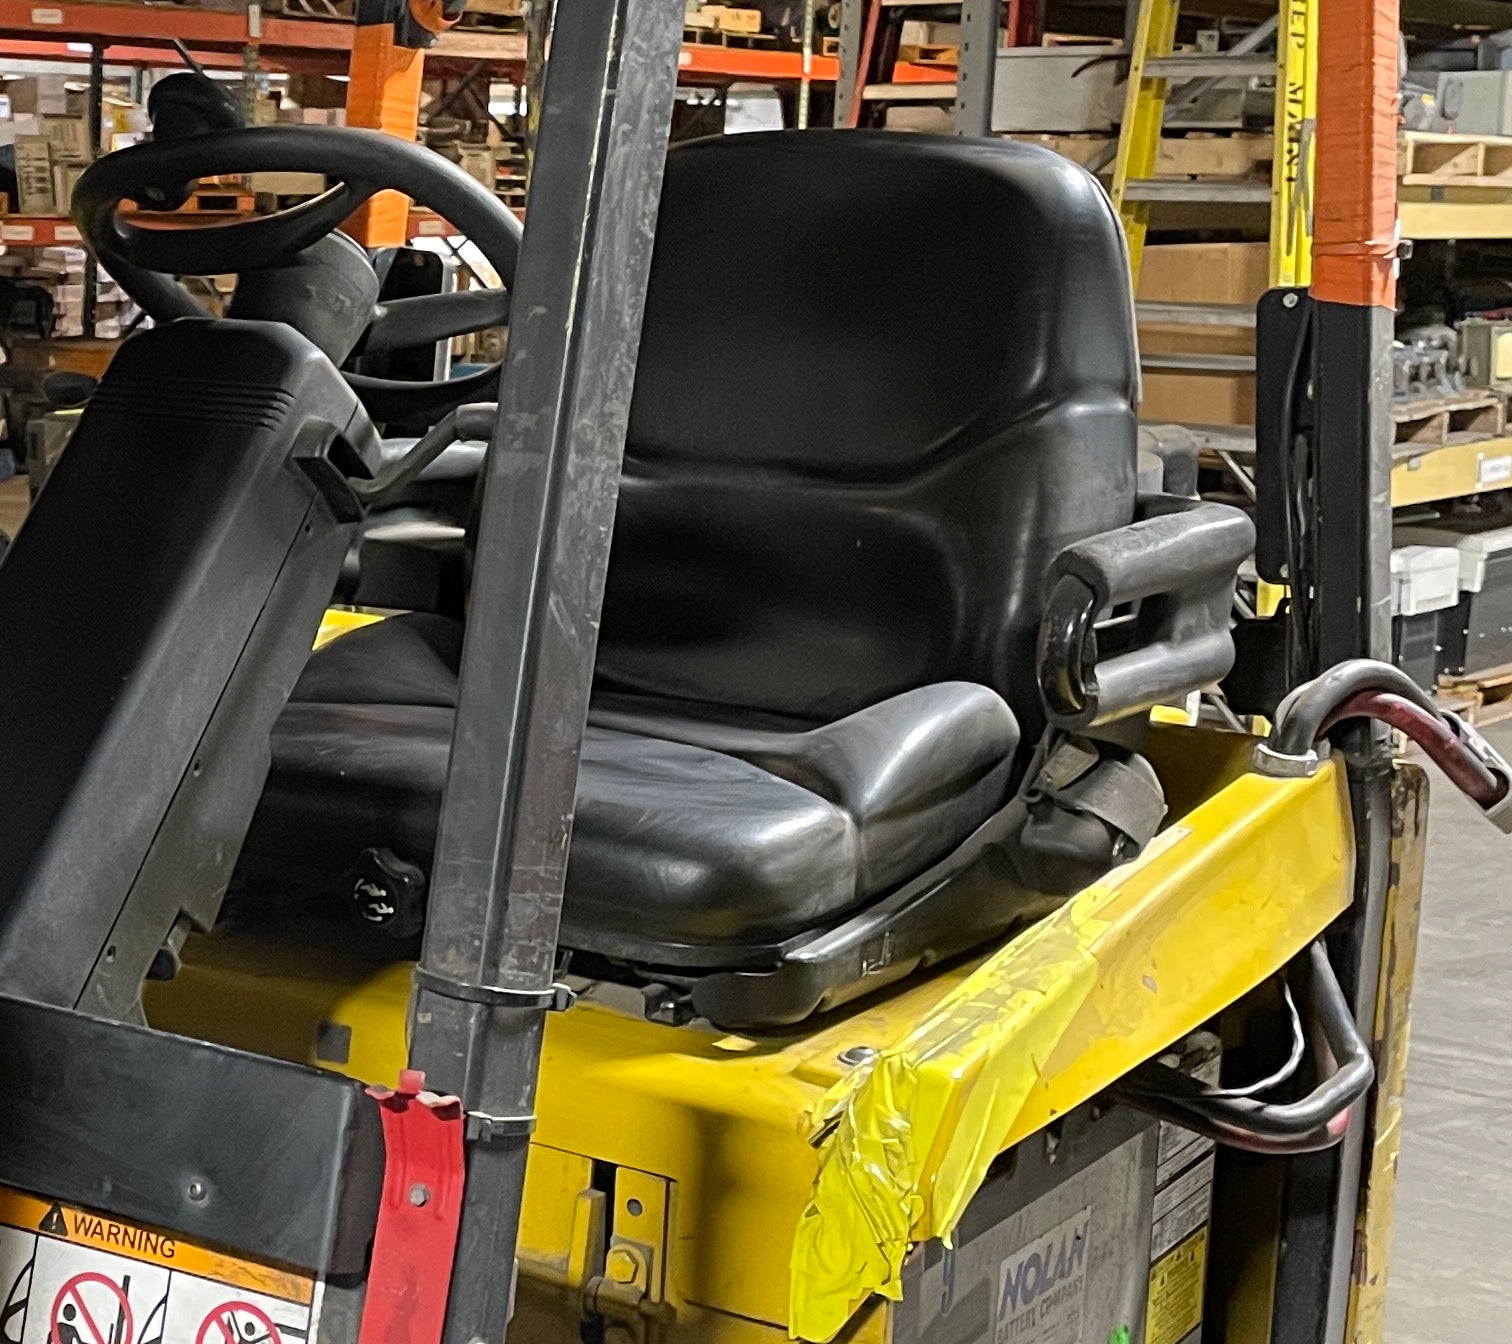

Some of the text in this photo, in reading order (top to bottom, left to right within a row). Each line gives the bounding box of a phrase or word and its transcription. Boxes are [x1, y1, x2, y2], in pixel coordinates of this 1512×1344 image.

[73, 1213, 177, 1259] WARNING
[998, 1219, 1090, 1324] NOLAN
[1039, 1274, 1083, 1320] COMPANY
